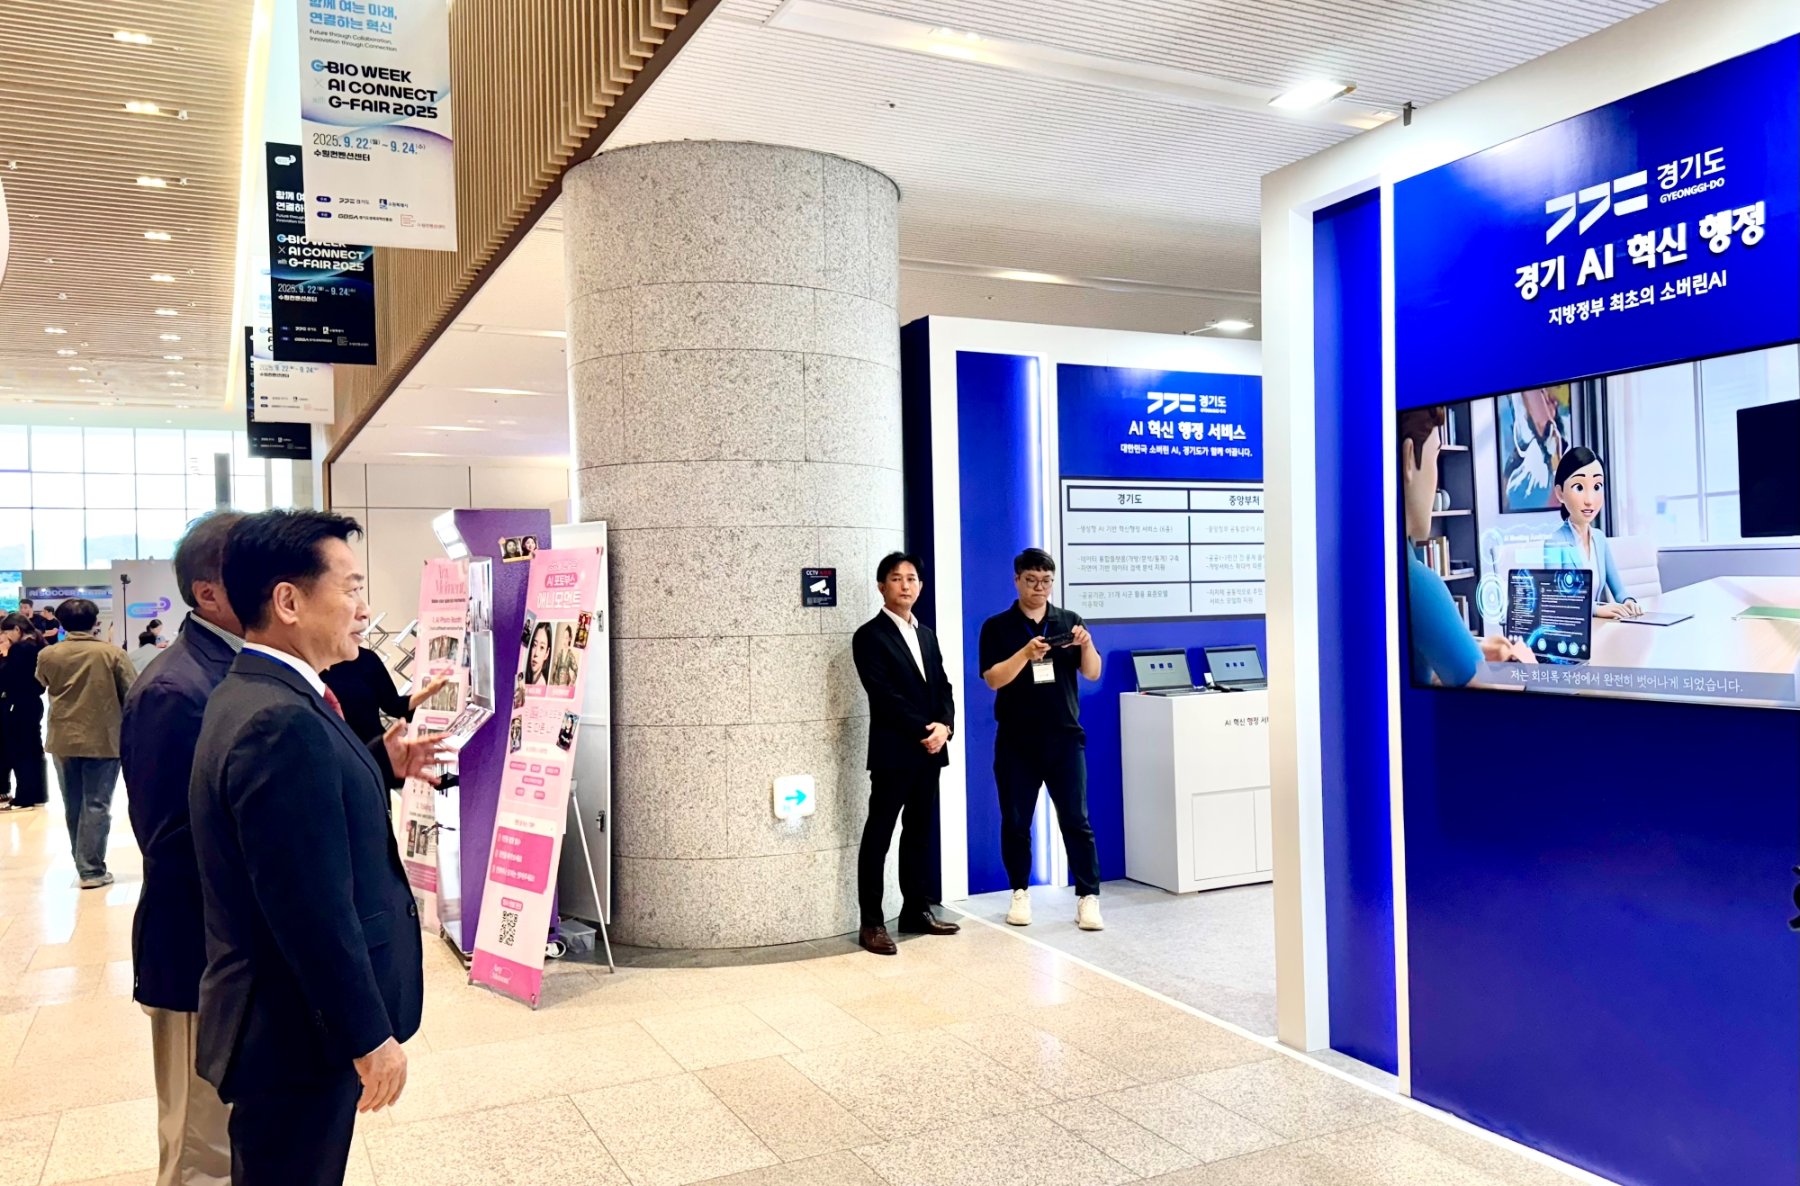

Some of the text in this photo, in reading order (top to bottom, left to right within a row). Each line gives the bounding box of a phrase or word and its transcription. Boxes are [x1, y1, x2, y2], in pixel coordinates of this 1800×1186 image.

[368, 3, 397, 20] 미래,
[309, 12, 392, 34] 연결하는 혁신
[309, 36, 397, 52] Innovation through Connection
[329, 31, 351, 40] through
[352, 34, 393, 45] Collaboration,
[361, 65, 412, 83] WEEK
[328, 78, 345, 92] AI
[348, 81, 438, 102] CONNECT
[328, 95, 390, 114] G-FAIR
[393, 103, 438, 119] 2025
[313, 133, 342, 147] 2025.
[1657, 147, 1726, 190] 경기도
[1660, 177, 1725, 204] GYEONGGI-DO
[276, 201, 305, 212] 연결하
[288, 246, 301, 256] AI
[302, 247, 364, 260] CONNECT
[1514, 201, 1766, 301] 경기 AI 혁신 행정
[288, 258, 331, 269] G-FAIR
[333, 261, 365, 272] 2025
[1548, 270, 1727, 325] 지방정부 최초의 소버린AI
[1199, 395, 1227, 408] 경기도
[1128, 420, 1246, 441] AI 혁신 행정 서비스
[1121, 444, 1147, 454] 대한민국
[1149, 445, 1169, 455] 소버린
[1171, 446, 1181, 456] AI,
[1183, 446, 1209, 456] 경기도가
[1210, 447, 1224, 456] 함께
[1118, 494, 1142, 505] 경기도
[1229, 495, 1260, 506] 중앙부처
[1106, 525, 1117, 533] 기반
[1141, 525, 1158, 533] 서비스
[1099, 564, 1111, 572] 기반
[1111, 564, 1129, 572] 데이터
[1130, 564, 1141, 572] 검색
[547, 574, 575, 586] AI 포토부스
[537, 591, 582, 609] 애니모먼트
[1107, 591, 1120, 599] 31개
[1121, 591, 1133, 599] 시군
[1146, 590, 1168, 598] 표준모델
[1510, 670, 1744, 693] 저는 회의록 작성에서 완전히 벗어나게 되었습니다.
[1233, 718, 1246, 726] 혁신
[1247, 717, 1259, 726] 행정
